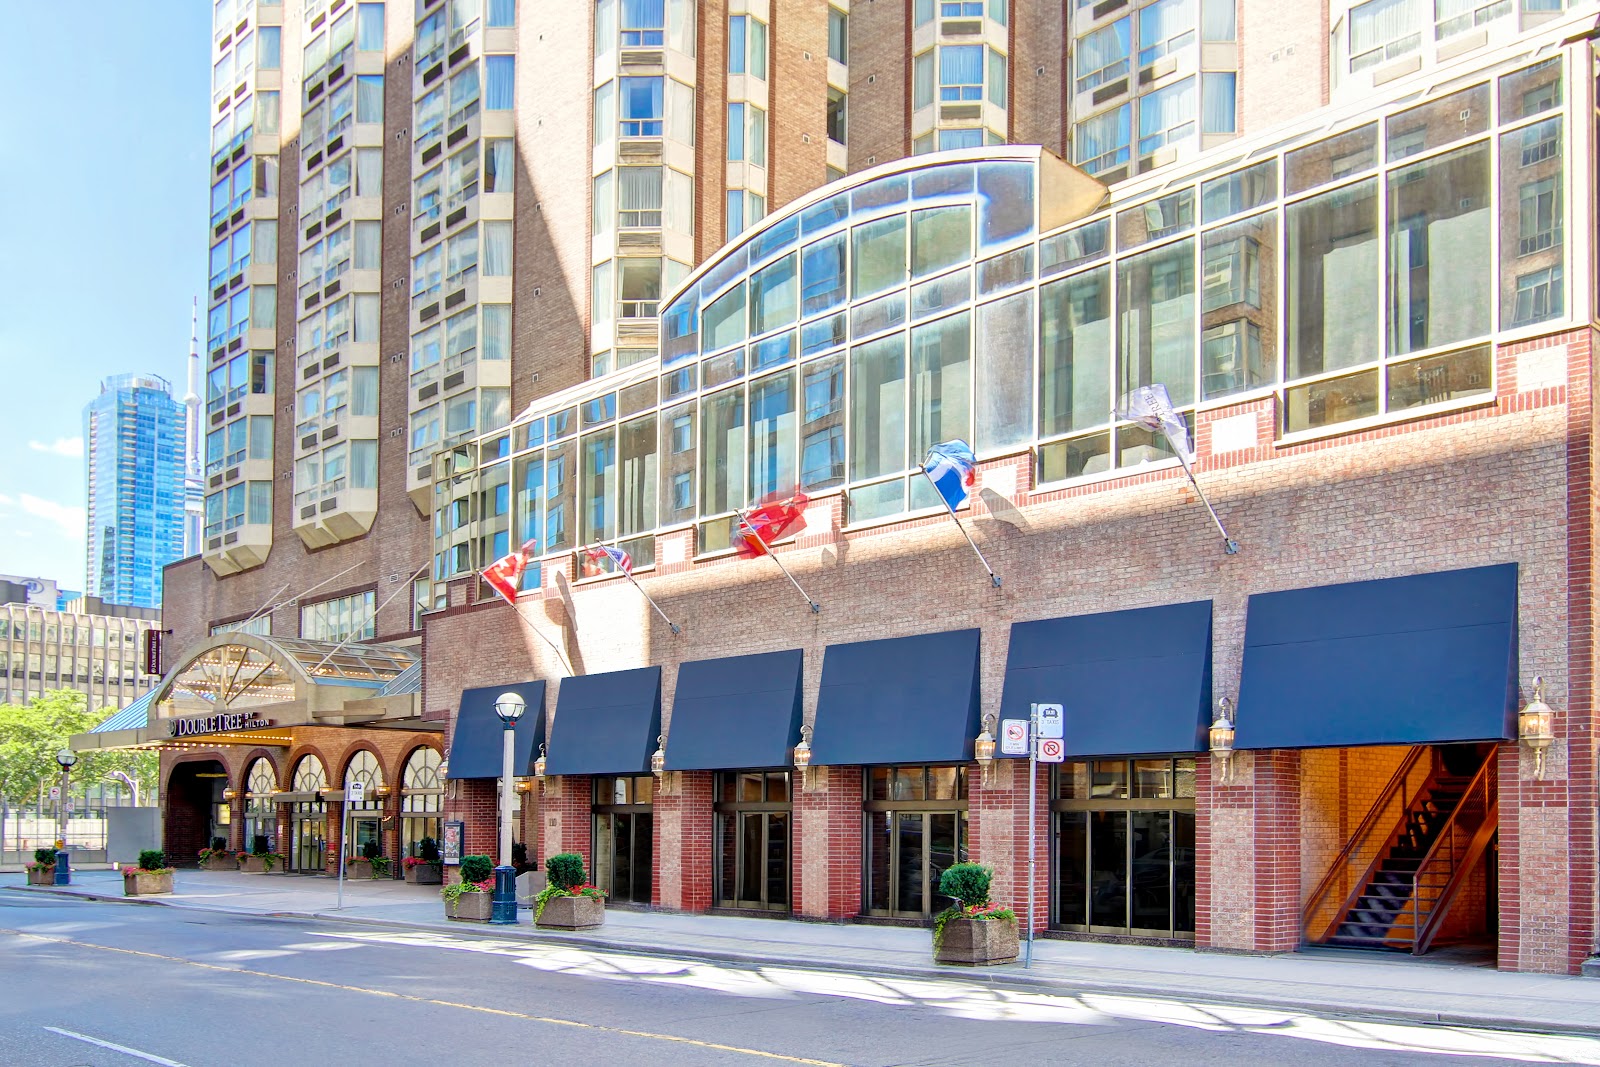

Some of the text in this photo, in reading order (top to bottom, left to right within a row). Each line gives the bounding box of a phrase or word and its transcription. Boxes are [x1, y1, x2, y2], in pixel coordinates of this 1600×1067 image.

[244, 712, 254, 720] BY
[179, 713, 243, 736] DOUBLETREE
[244, 719, 270, 728] HILTON
